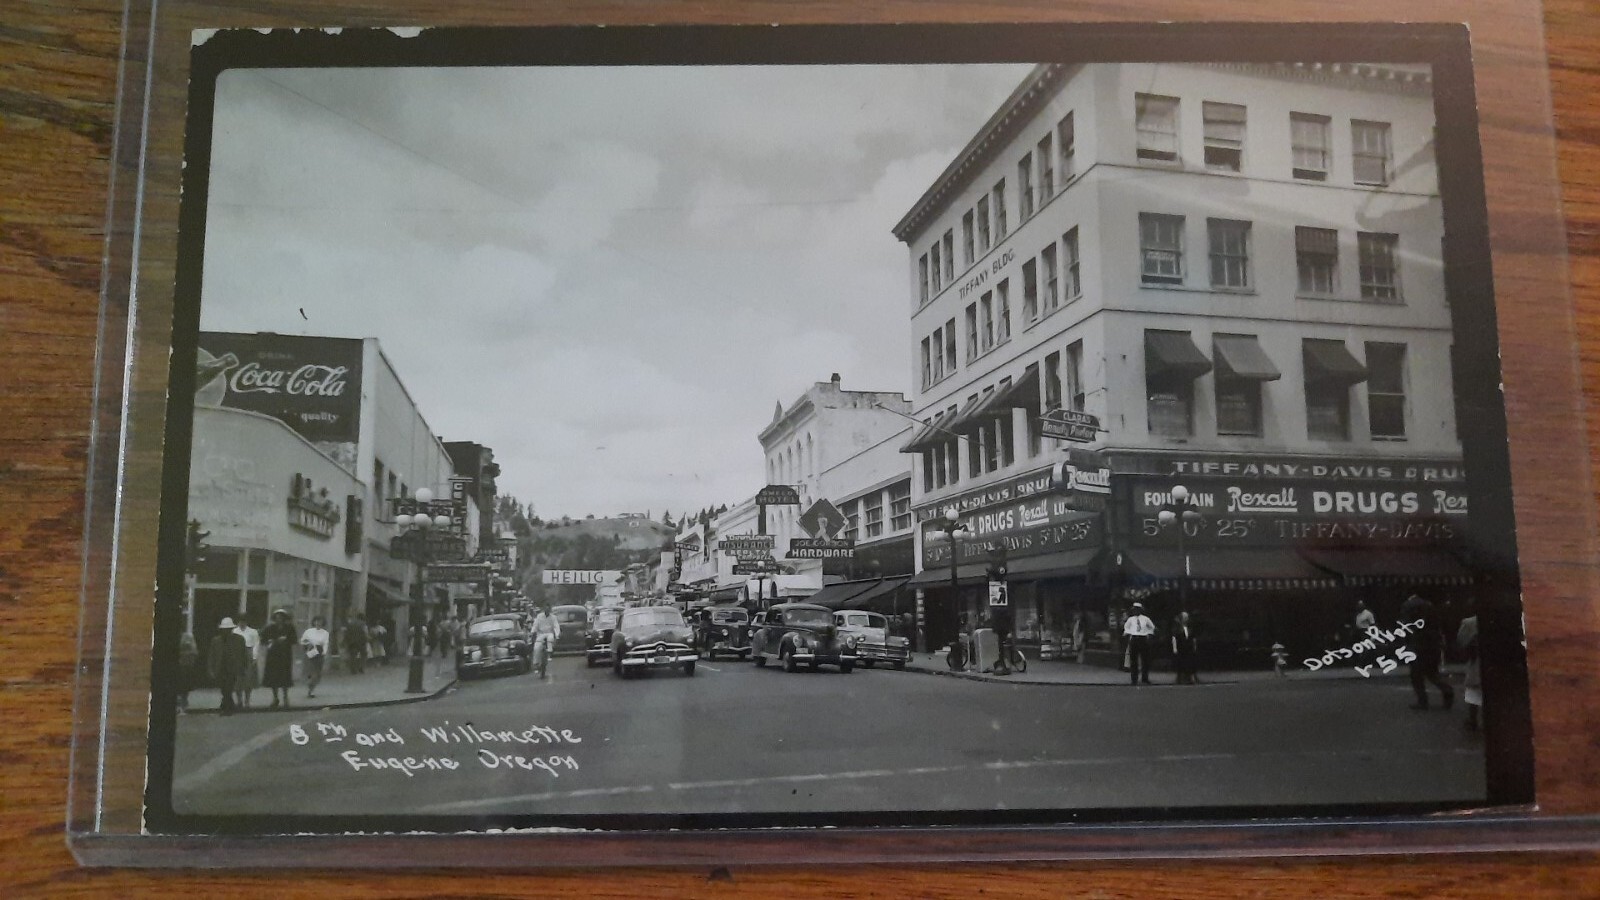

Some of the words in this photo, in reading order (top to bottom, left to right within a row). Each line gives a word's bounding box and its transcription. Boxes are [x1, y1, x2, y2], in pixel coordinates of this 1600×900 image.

[959, 270, 989, 299] TIFFANY
[230, 362, 349, 397] Coca-Cola
[301, 412, 339, 423] quality
[1066, 465, 1111, 494] Rexall
[759, 495, 797, 504] HOTEL
[1226, 486, 1298, 513] Rexall
[1313, 491, 1419, 514] DRUGS
[978, 509, 1014, 535] DRUGS
[1018, 498, 1049, 529] Rexall
[791, 548, 855, 558] HARDWARE
[551, 571, 604, 583] HEILIG
[355, 727, 405, 747] and
[420, 720, 583, 744] Willamette
[340, 749, 461, 778] Eugene
[478, 748, 580, 778] Oregon
